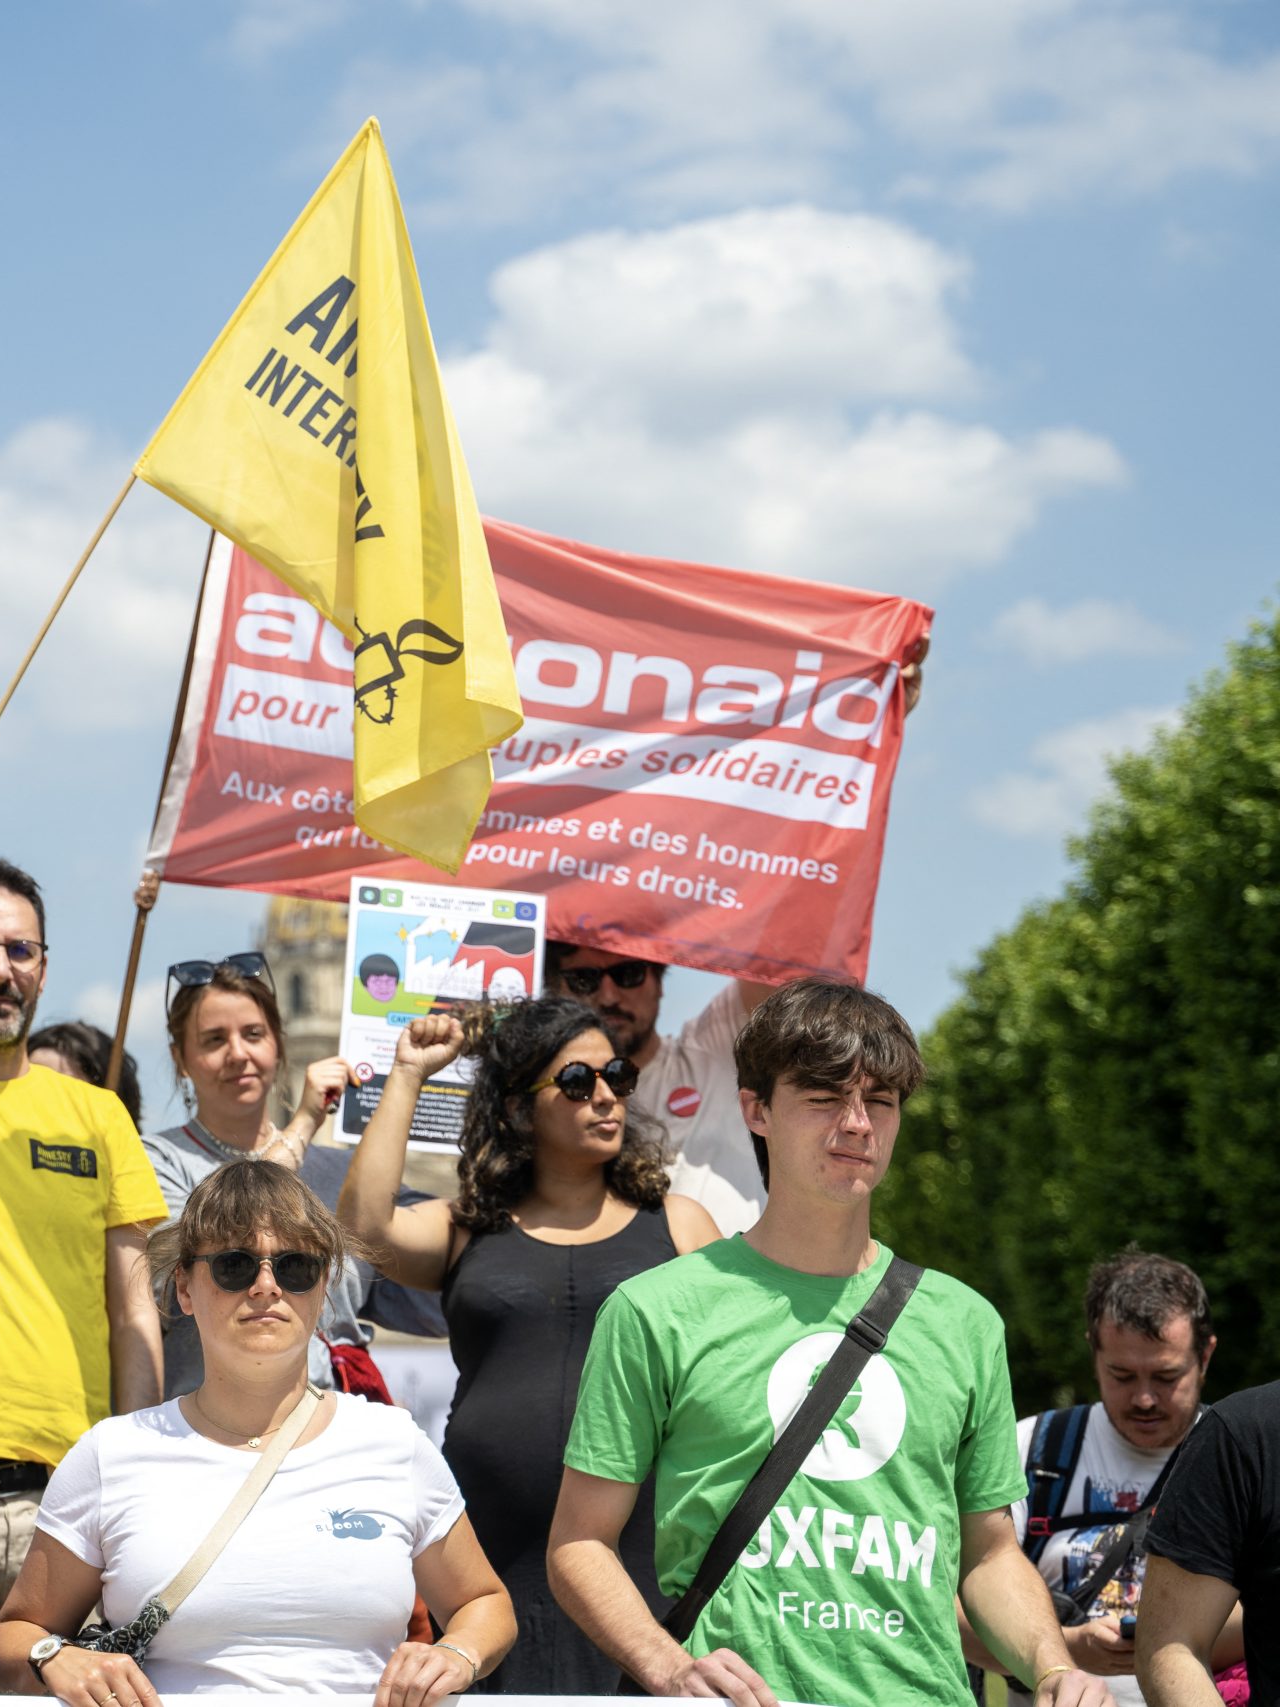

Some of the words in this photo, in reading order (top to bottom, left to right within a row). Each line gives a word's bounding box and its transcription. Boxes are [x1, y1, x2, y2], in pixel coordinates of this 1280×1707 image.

[228, 689, 339, 730] pour
[489, 738, 628, 772] uples
[641, 750, 861, 806] solidaires
[221, 771, 286, 806] Aux
[587, 820, 622, 843] et
[629, 822, 688, 856] des
[696, 833, 840, 884] hommes
[295, 826, 345, 849] qui
[465, 843, 544, 869] pour
[548, 847, 630, 886] leurs
[637, 865, 744, 910] droits.
[315, 1520, 364, 1532] BLOOM
[778, 1591, 905, 1637] France
